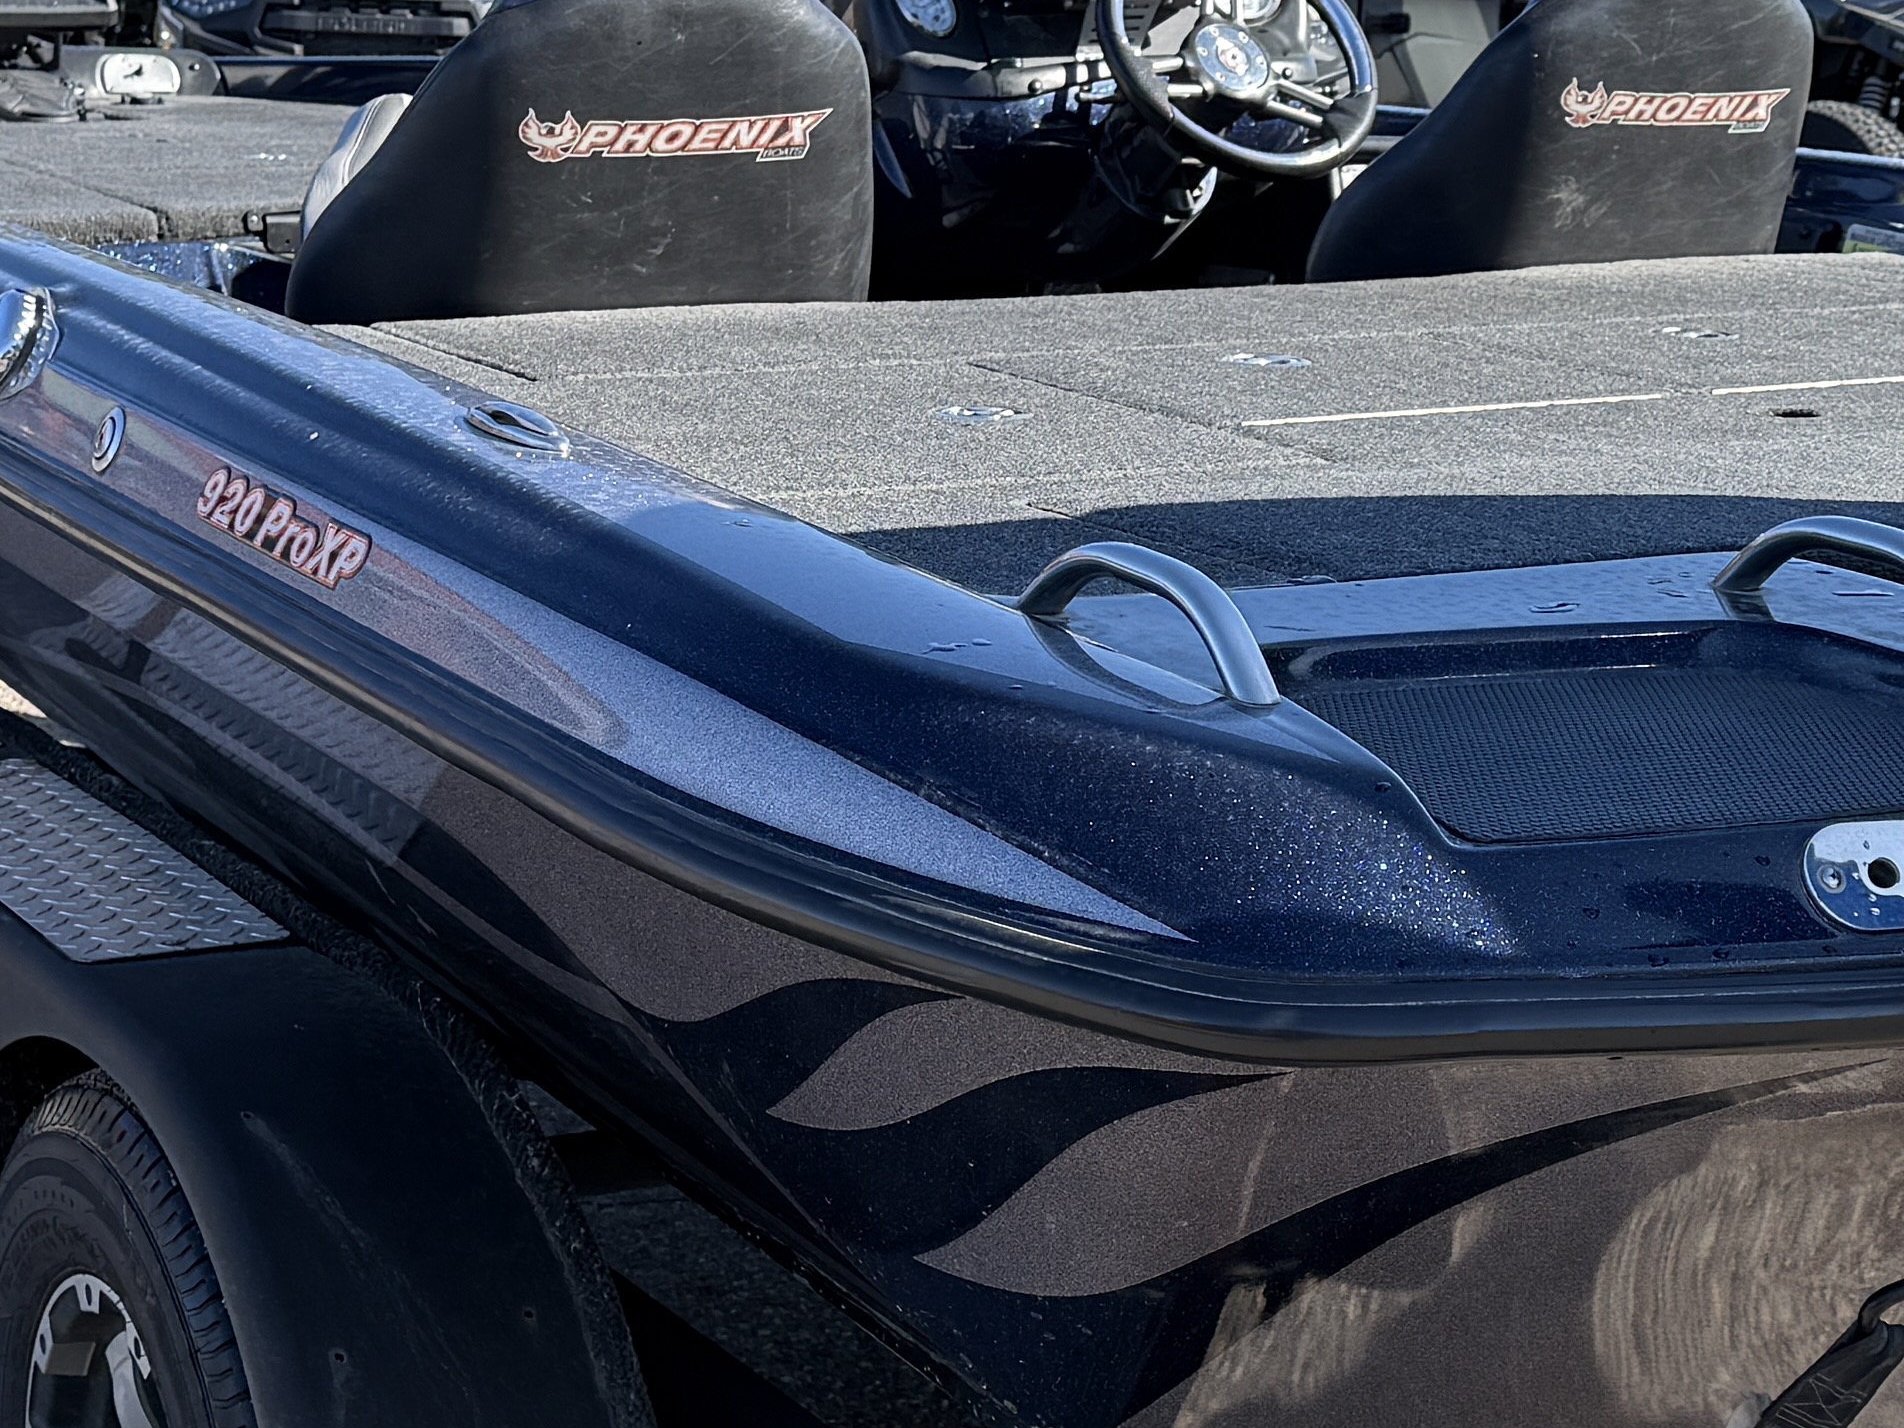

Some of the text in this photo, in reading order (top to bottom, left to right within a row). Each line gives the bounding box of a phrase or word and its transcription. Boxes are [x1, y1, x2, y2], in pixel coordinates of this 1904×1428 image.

[1595, 91, 1787, 125] PHOENIX
[568, 112, 828, 156] PHOENIX
[197, 467, 267, 537] 920
